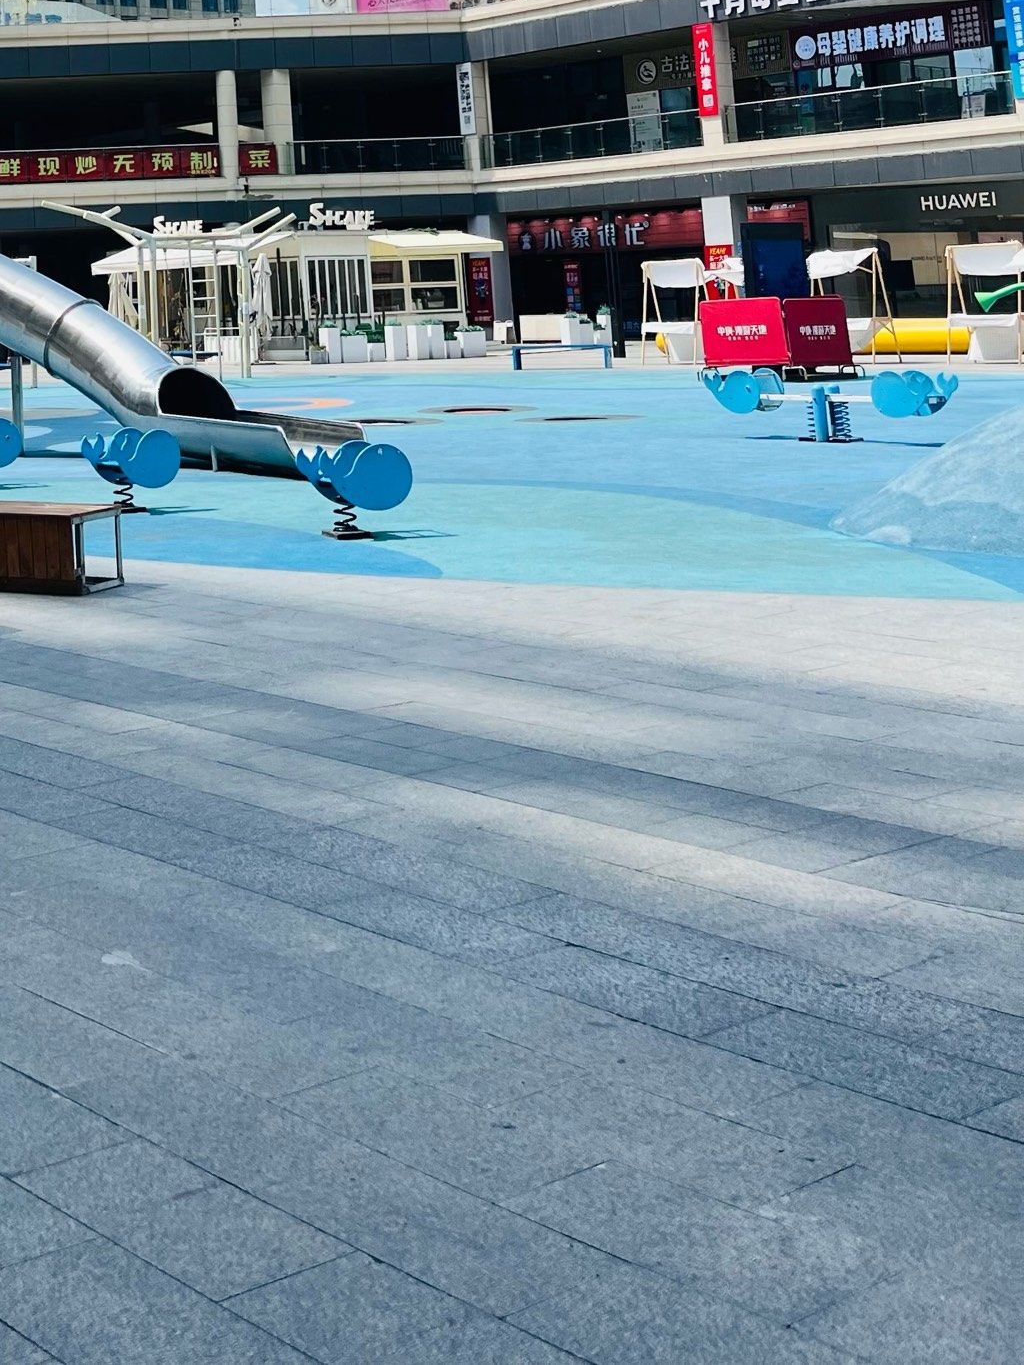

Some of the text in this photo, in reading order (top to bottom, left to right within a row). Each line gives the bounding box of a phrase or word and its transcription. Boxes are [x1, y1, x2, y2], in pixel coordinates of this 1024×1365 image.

[698, 38, 713, 92] 小儿推拿
[920, 191, 997, 212] HUAWEI
